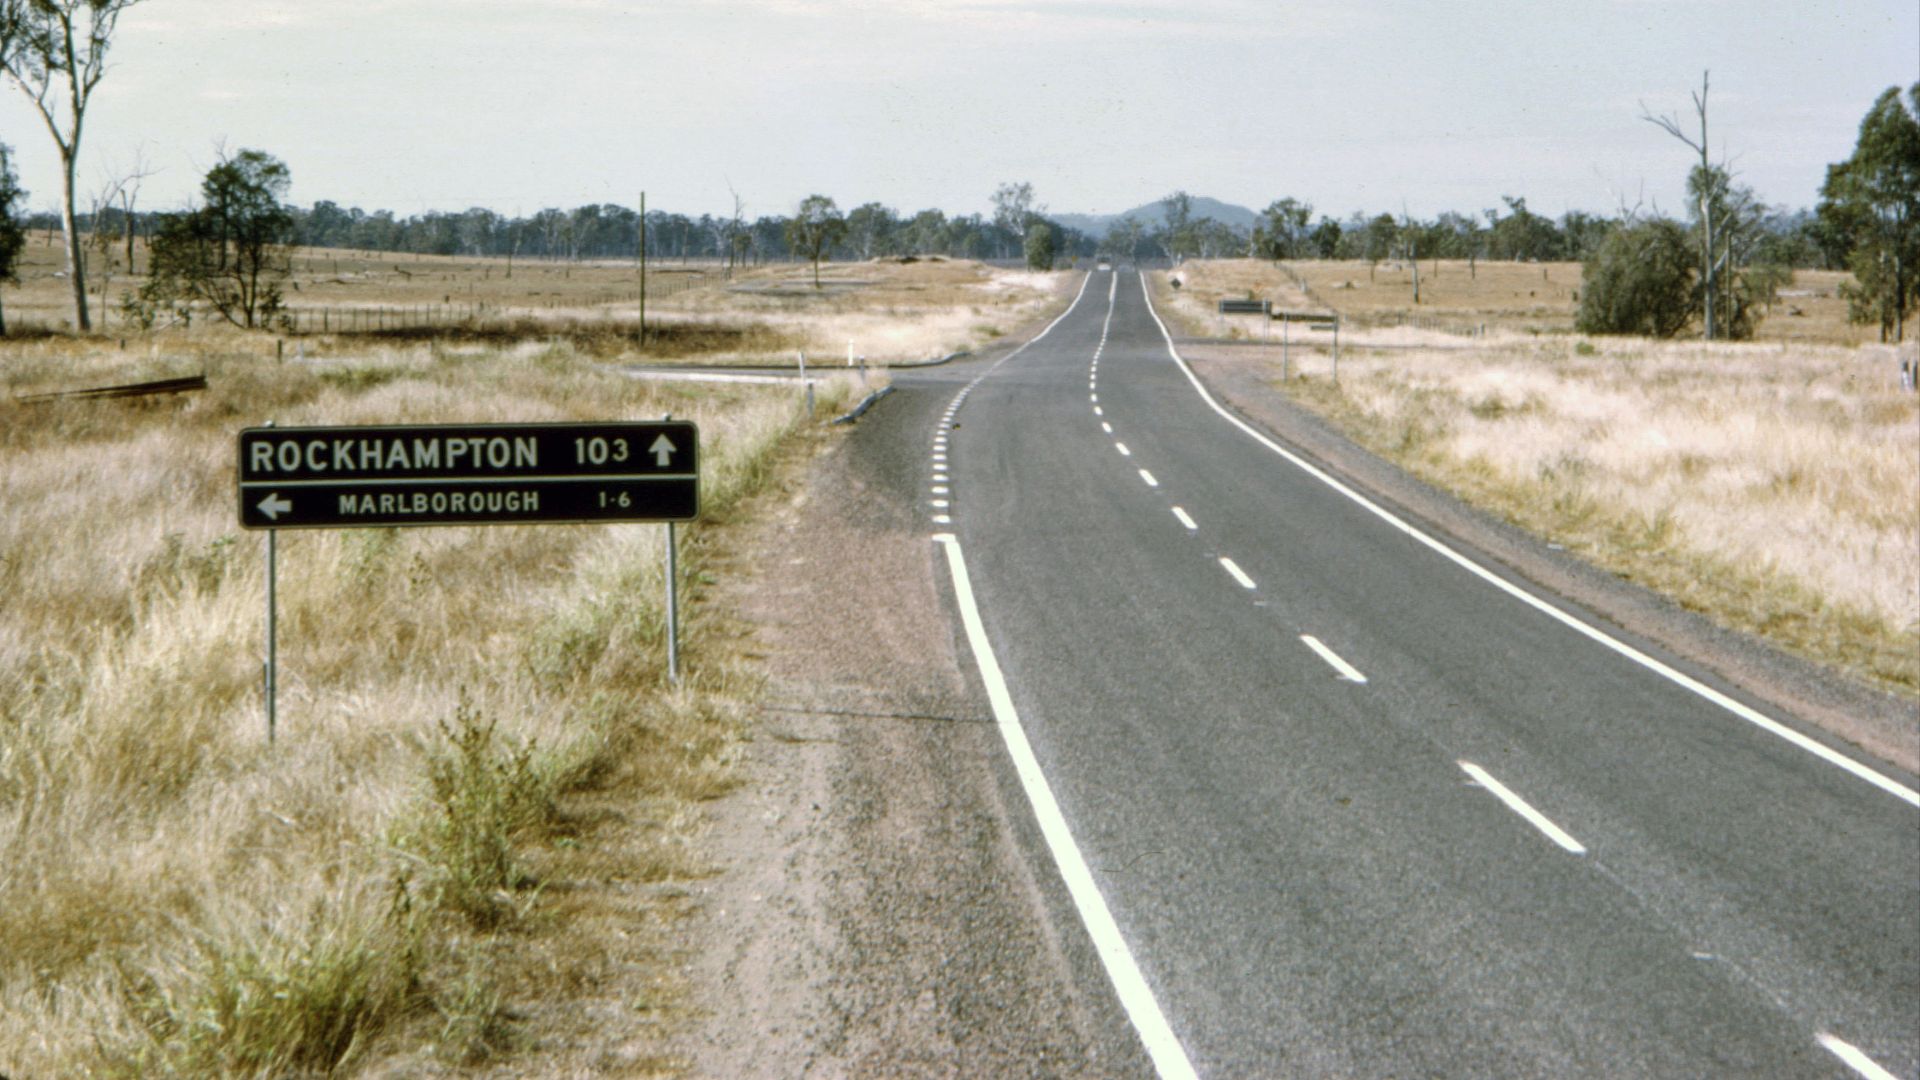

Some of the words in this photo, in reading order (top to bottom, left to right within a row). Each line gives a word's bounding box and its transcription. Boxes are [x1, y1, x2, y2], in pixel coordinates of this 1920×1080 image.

[250, 437, 538, 472] ROCKHAMPTON
[575, 437, 629, 465] 103
[338, 491, 539, 514] MARLBOROUGH
